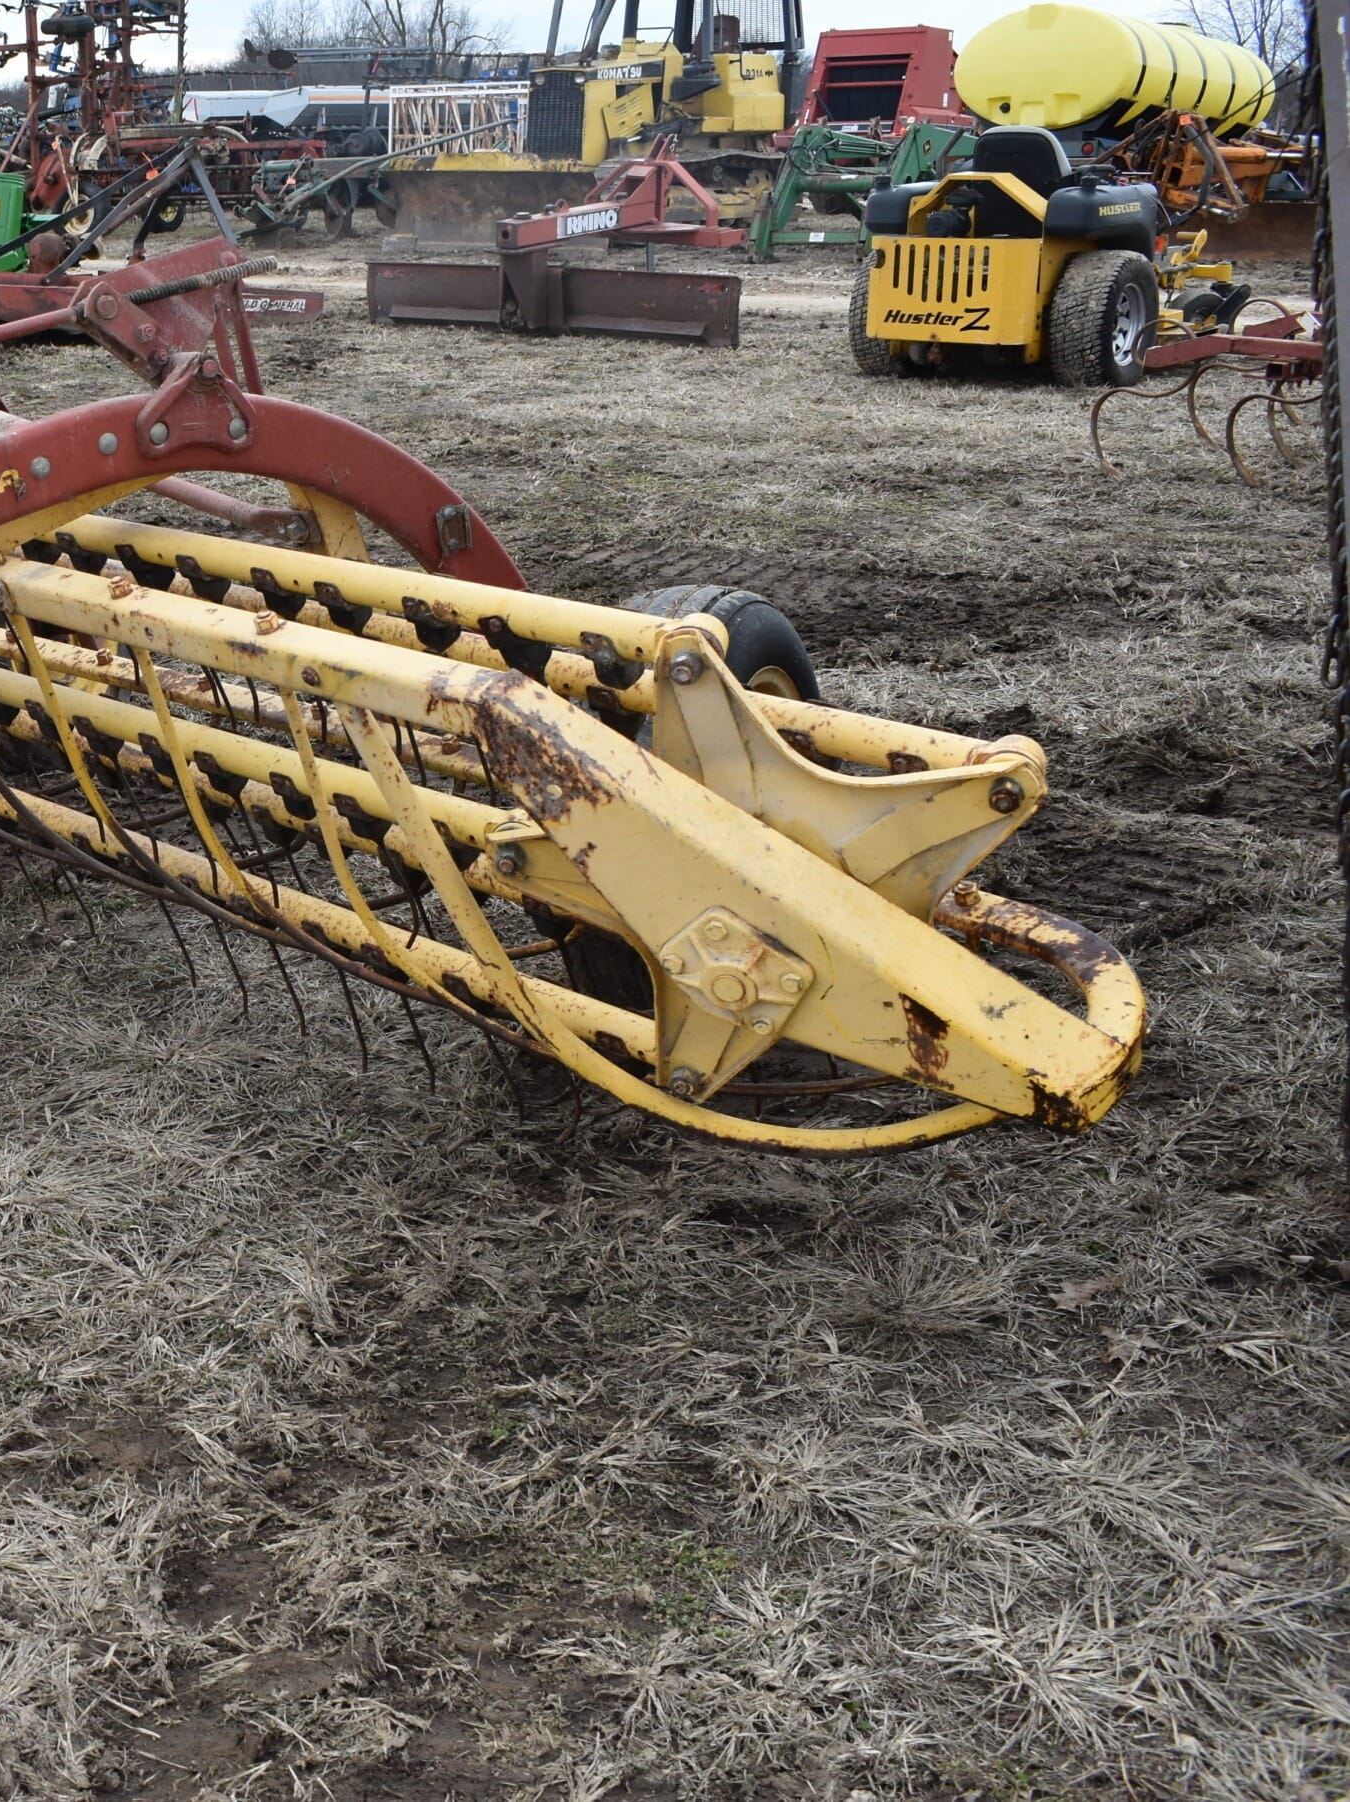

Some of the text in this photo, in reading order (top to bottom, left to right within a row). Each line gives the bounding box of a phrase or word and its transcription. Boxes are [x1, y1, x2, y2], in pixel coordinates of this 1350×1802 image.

[597, 65, 642, 80] KOMATSU
[1098, 202, 1141, 217] HUSTLER
[567, 209, 617, 235] RHINO
[883, 307, 991, 332] Hustler Z
